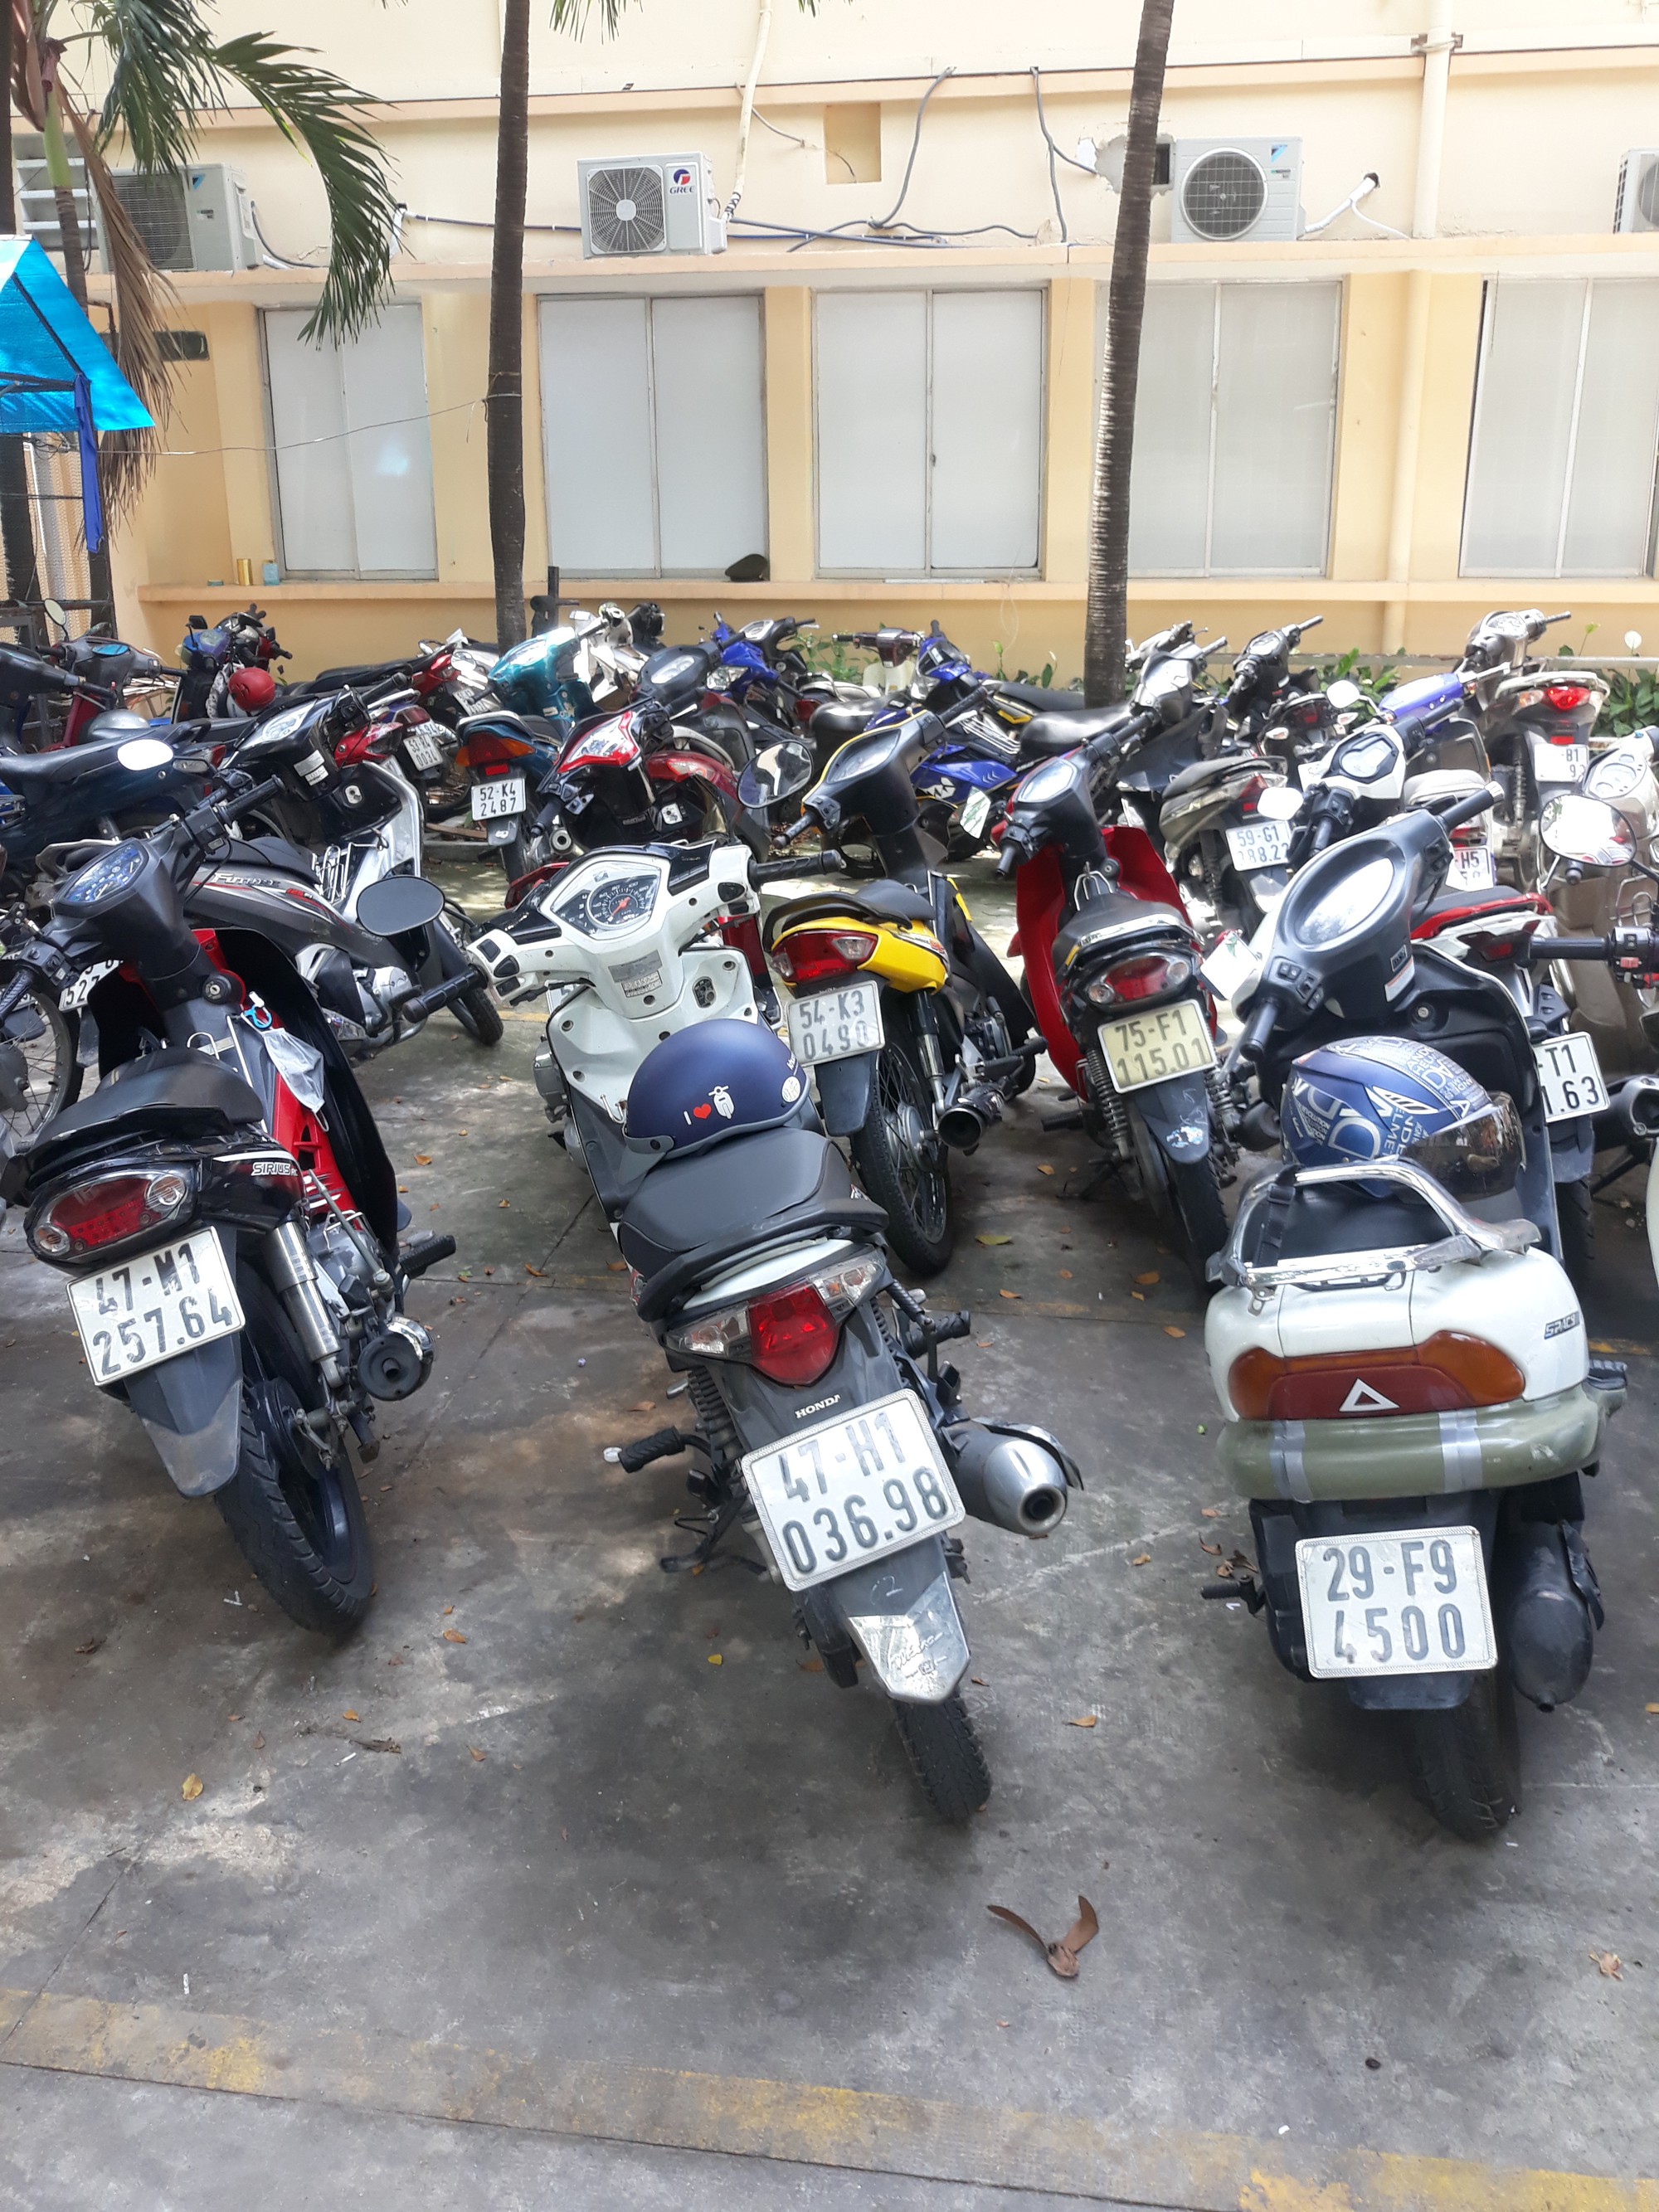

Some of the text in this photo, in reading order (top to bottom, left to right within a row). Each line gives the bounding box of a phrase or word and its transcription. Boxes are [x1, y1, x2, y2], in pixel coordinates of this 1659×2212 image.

[669, 186, 696, 194] GREE
[479, 782, 516, 801] 52-K4
[480, 797, 516, 817] 2487
[1237, 824, 1280, 847] 59-G1
[799, 990, 865, 1029] 54-K3
[1115, 1009, 1188, 1052] 75-F1
[1117, 1037, 1209, 1086] 115.01
[251, 1161, 291, 1176] SIRIUS
[92, 1286, 232, 1376] 257.64
[795, 1393, 841, 1419] HONDA
[777, 1412, 906, 1503] 47-H1
[781, 1465, 948, 1574] 036.98
[1323, 1539, 1457, 1602] 29-F9
[1334, 1602, 1466, 1664] 4500
